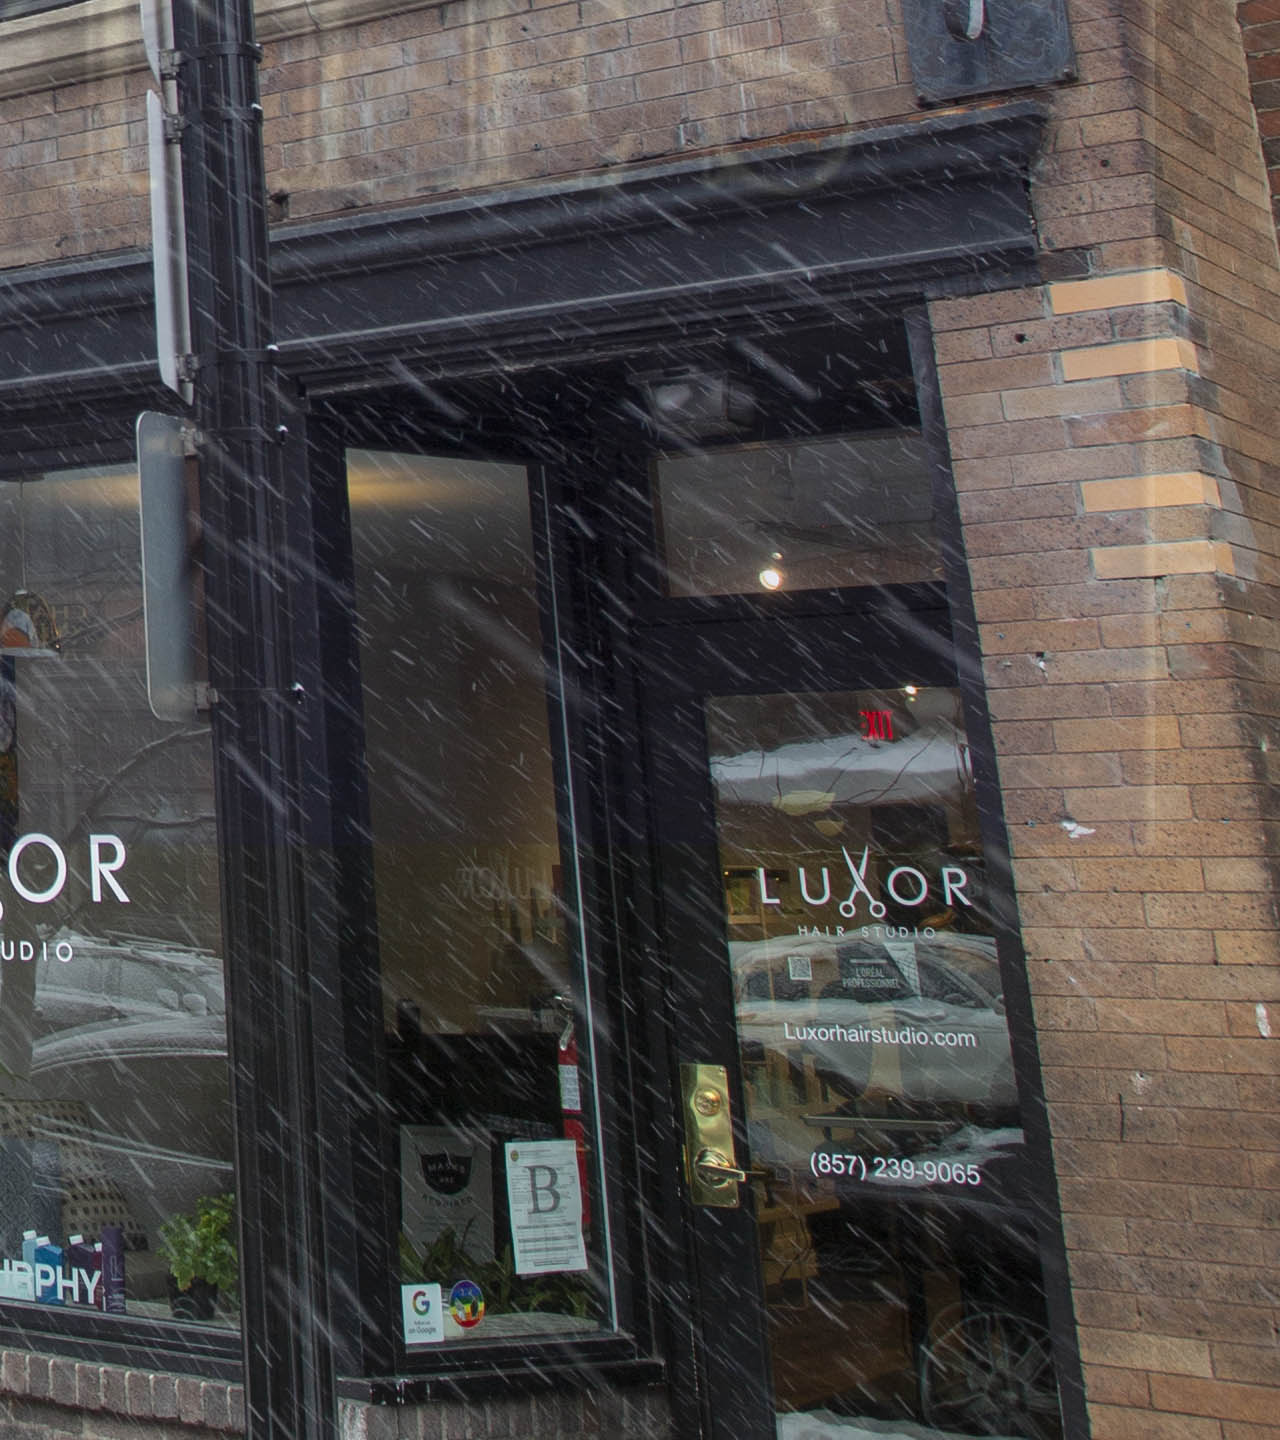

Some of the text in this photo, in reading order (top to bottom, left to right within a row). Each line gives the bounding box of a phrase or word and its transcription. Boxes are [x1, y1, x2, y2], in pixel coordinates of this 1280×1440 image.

[758, 846, 973, 918] LUXOR
[797, 924, 937, 940] HAIR STUDIO
[783, 1022, 978, 1048] Luxorhairstudio.com
[810, 1152, 983, 1185] (857) 239-9065
